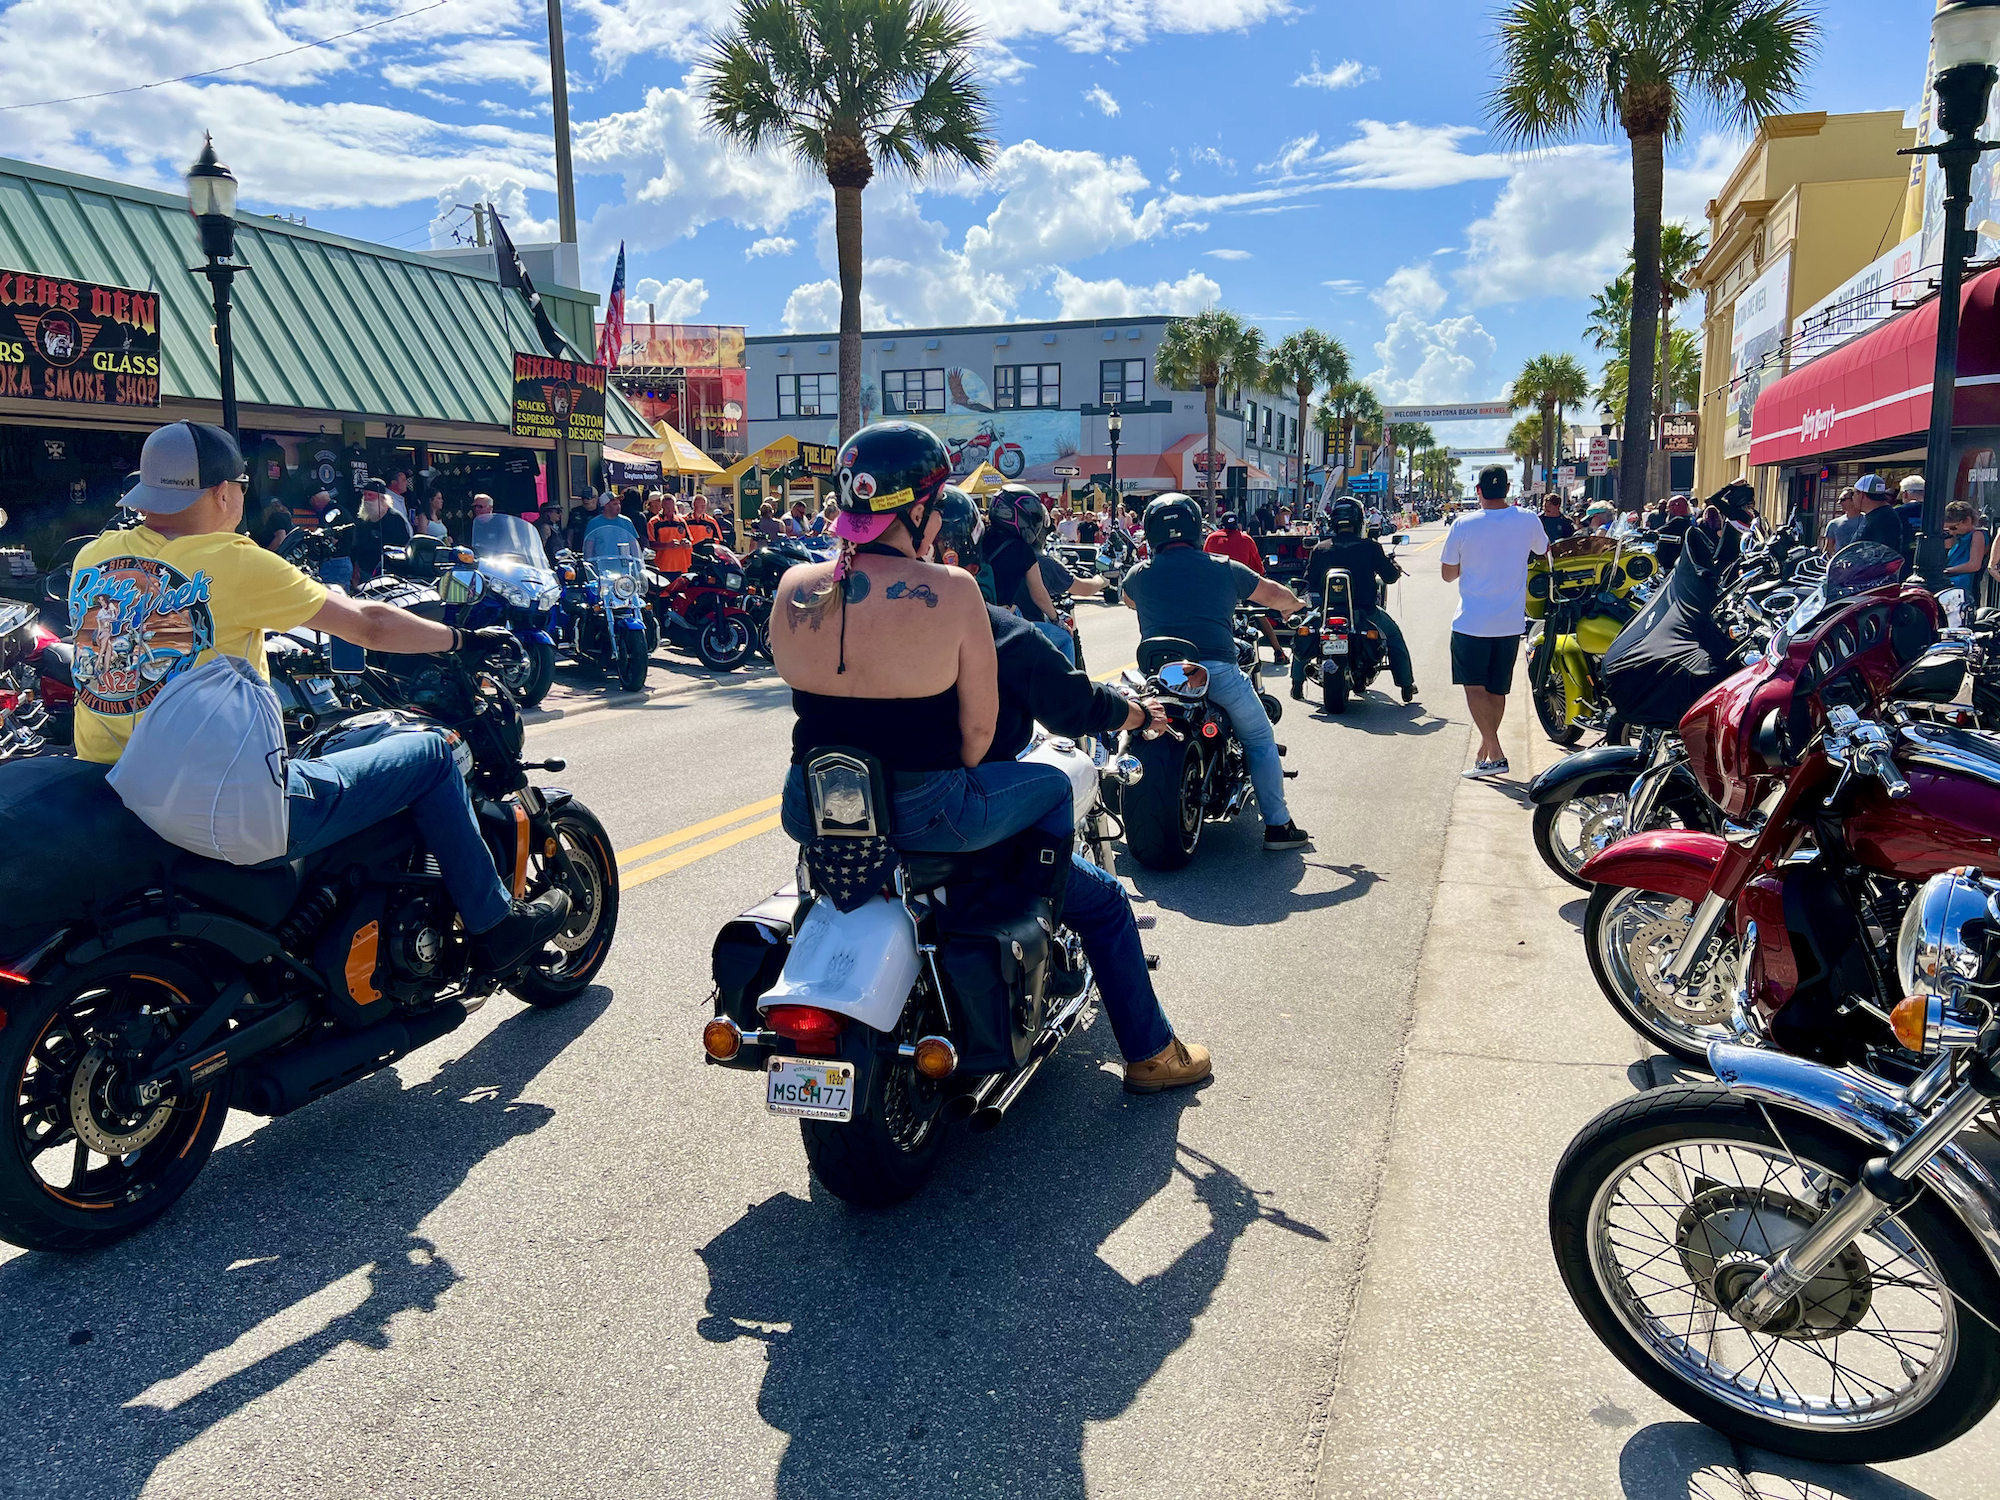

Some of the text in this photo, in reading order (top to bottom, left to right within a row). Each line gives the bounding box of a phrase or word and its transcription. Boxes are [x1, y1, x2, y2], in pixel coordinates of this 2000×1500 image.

[1856, 269, 1882, 323] WEEK
[90, 286, 157, 336] DEN
[93, 352, 160, 376] GLASS
[515, 355, 606, 395] BIKERS DEN
[44, 367, 106, 402] SMOKE
[116, 374, 158, 406] SHOP
[517, 400, 546, 413] SNACKS
[691, 404, 726, 419] FULL
[1479, 407, 1492, 415] BIKE
[516, 412, 555, 426] ESPRESSO
[569, 413, 604, 428] CUSTOM
[694, 417, 738, 432] MOON
[516, 425, 563, 439] SOFT DRINKS
[568, 427, 604, 441] DESIGNS
[1663, 421, 1695, 436] Bank
[802, 445, 837, 470] THE LOT
[624, 472, 658, 480] Daytona Beach
[1116, 482, 1138, 490] OTURE
[1197, 481, 1222, 489] OUT
[70, 567, 213, 636] Bike Week
[97, 669, 141, 694] 2022
[80, 682, 165, 714] DAYTONA BEACH
[773, 1083, 846, 1106] MSCH77
[806, 1109, 838, 1118] CUSTOMS
